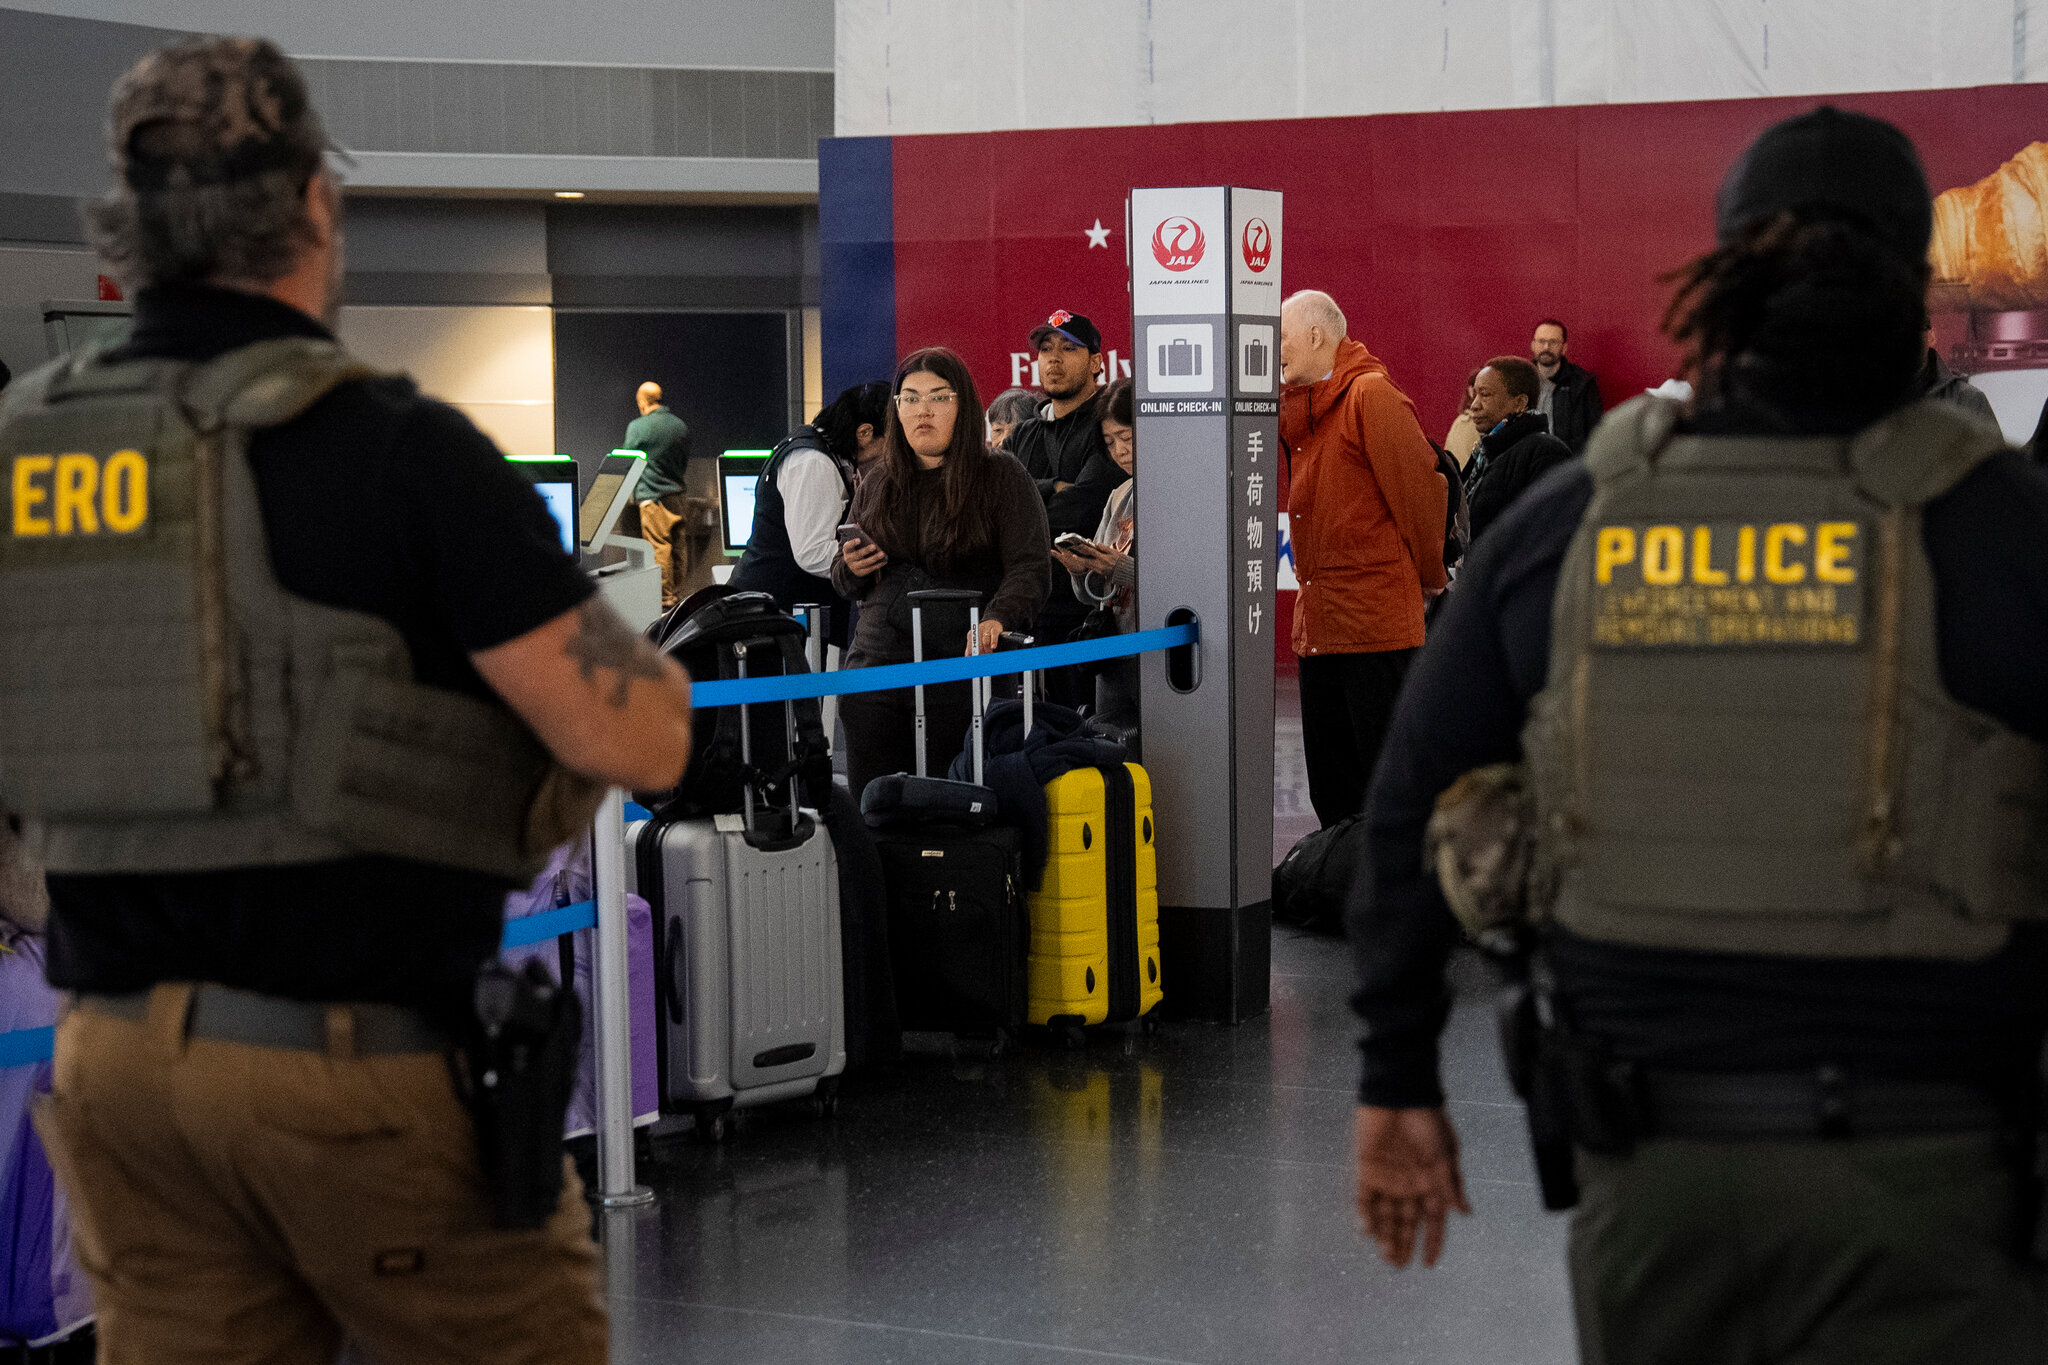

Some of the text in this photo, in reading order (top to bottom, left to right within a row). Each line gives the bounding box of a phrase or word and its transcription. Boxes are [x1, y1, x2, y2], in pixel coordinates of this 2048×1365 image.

[1166, 255, 1195, 265] JAL
[1250, 257, 1266, 266] JAL
[1140, 401, 1222, 412] ONLINE CHECK-IN
[1235, 402, 1277, 412] ONLINE CHECK-IN
[12, 449, 148, 537] ERO
[1247, 431, 1264, 635] 手荷物預け
[1596, 522, 1857, 584] POLICE
